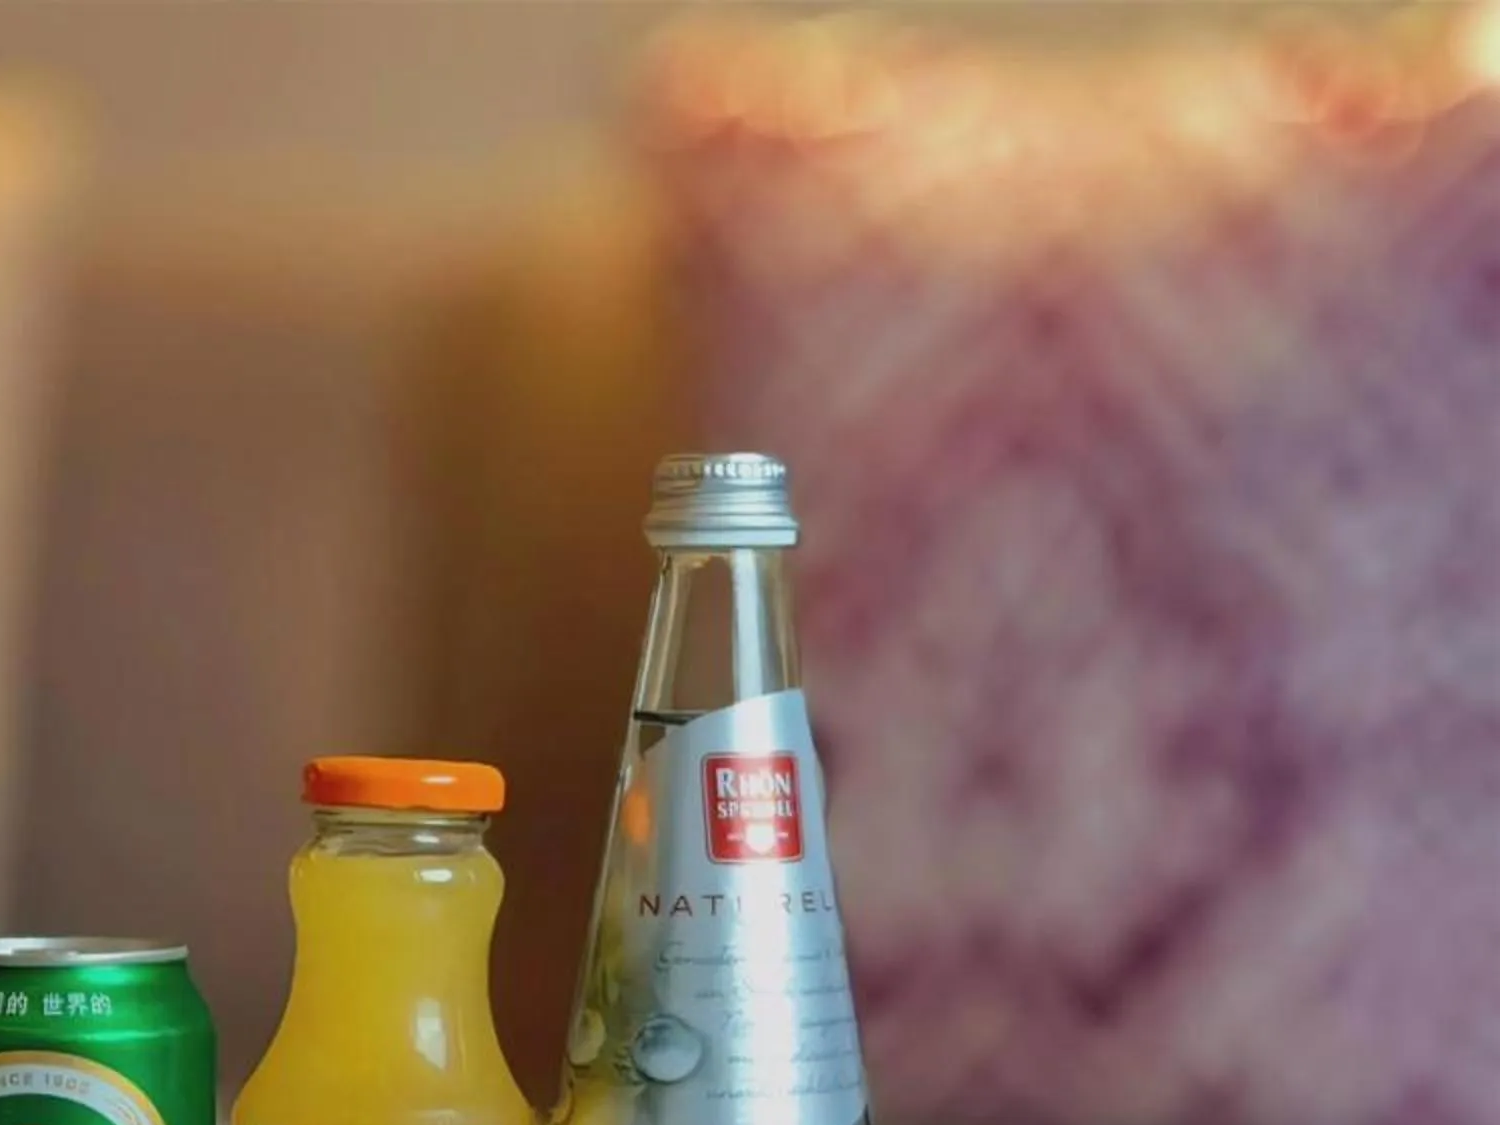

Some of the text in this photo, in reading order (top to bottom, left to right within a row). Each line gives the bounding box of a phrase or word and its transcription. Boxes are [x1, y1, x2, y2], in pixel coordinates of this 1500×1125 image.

[717, 800, 792, 818] SPEL
[639, 890, 834, 917] NATREL
[41, 992, 113, 1017] 世界的
